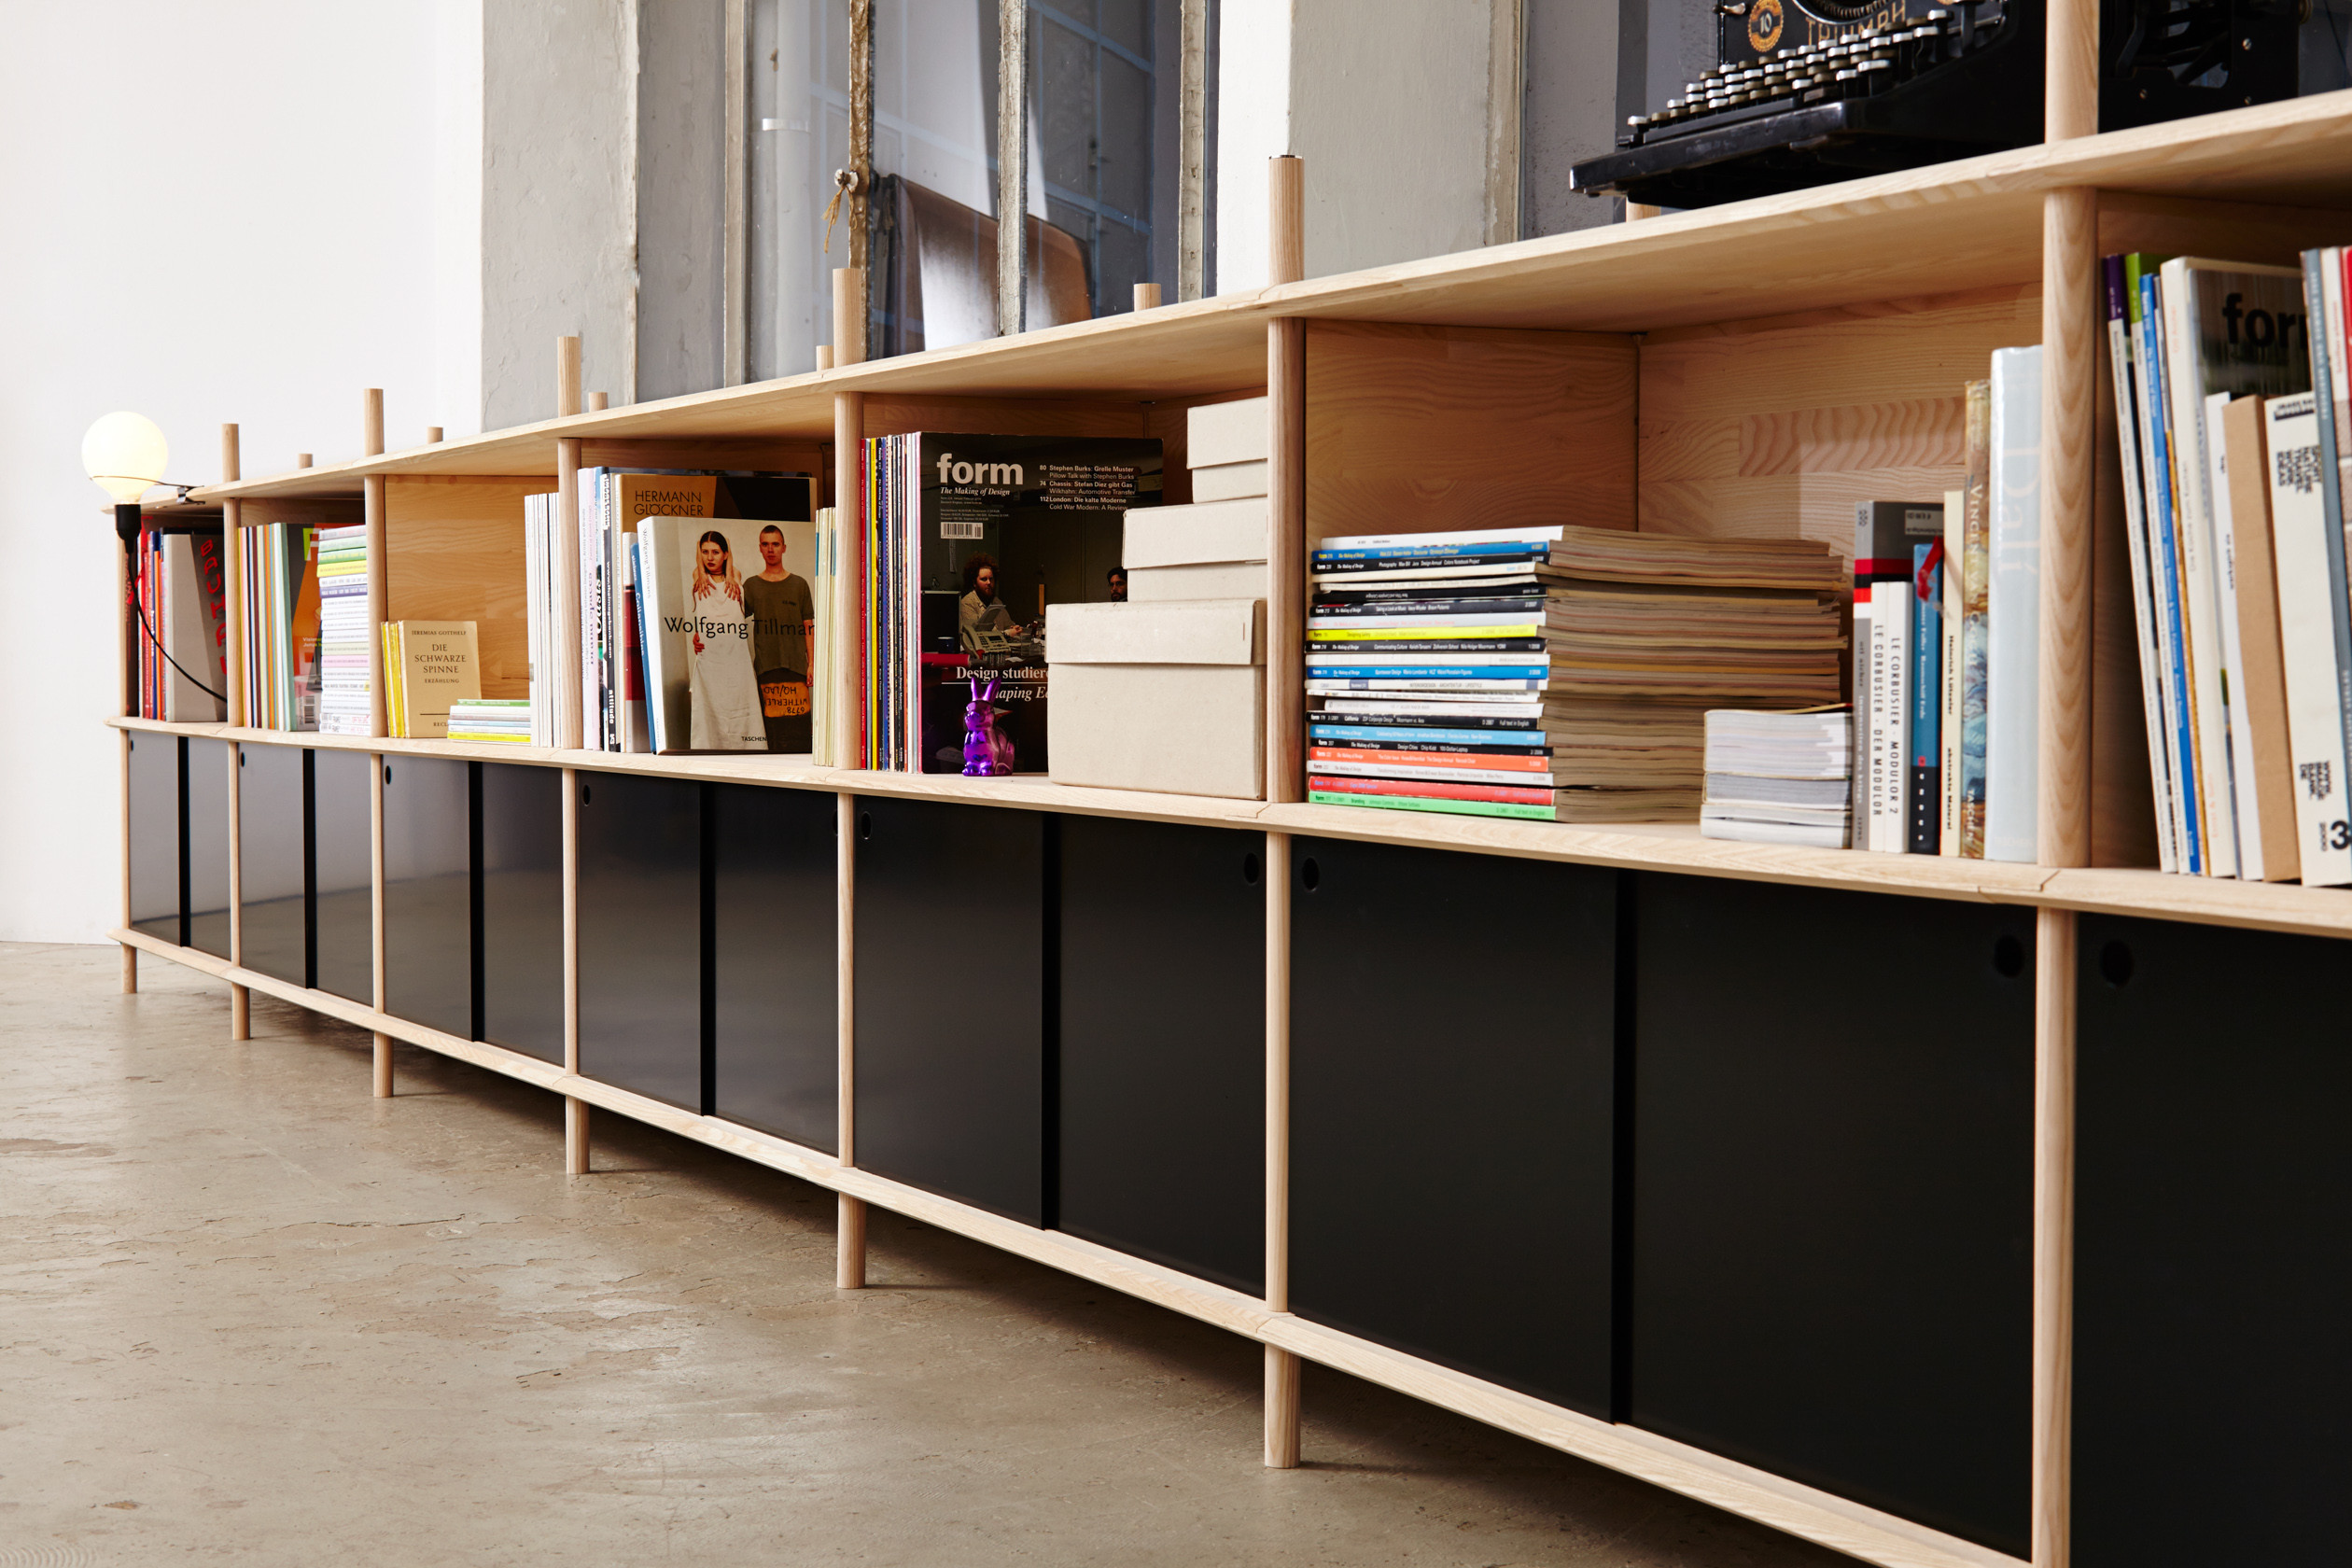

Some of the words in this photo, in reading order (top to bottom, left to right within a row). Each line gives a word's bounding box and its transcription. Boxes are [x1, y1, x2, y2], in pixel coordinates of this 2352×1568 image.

[1760, 14, 1771, 34] 10
[2221, 292, 2308, 349] for
[936, 453, 1024, 485] form
[635, 491, 701, 502] HERMANN
[941, 486, 953, 495] The
[954, 487, 979, 497] Making
[980, 488, 988, 497] of
[987, 488, 1011, 497] Design
[634, 503, 704, 516] GLÖCKNER
[664, 616, 749, 639] Wolfgang
[751, 619, 815, 636] Tillman
[1875, 624, 1884, 637] LE
[1892, 637, 1901, 651] LE
[414, 654, 467, 663] SCHWARZE
[956, 666, 999, 681] Design
[1874, 644, 1883, 713] CORBUSIER
[1891, 655, 1900, 726] CORBUSIER
[1873, 729, 1883, 752] DER
[1889, 741, 1899, 802] MODULOR
[1873, 758, 1883, 816] MODULOR
[1967, 789, 1975, 841] TASCHEN
[2331, 819, 2351, 850] 3
